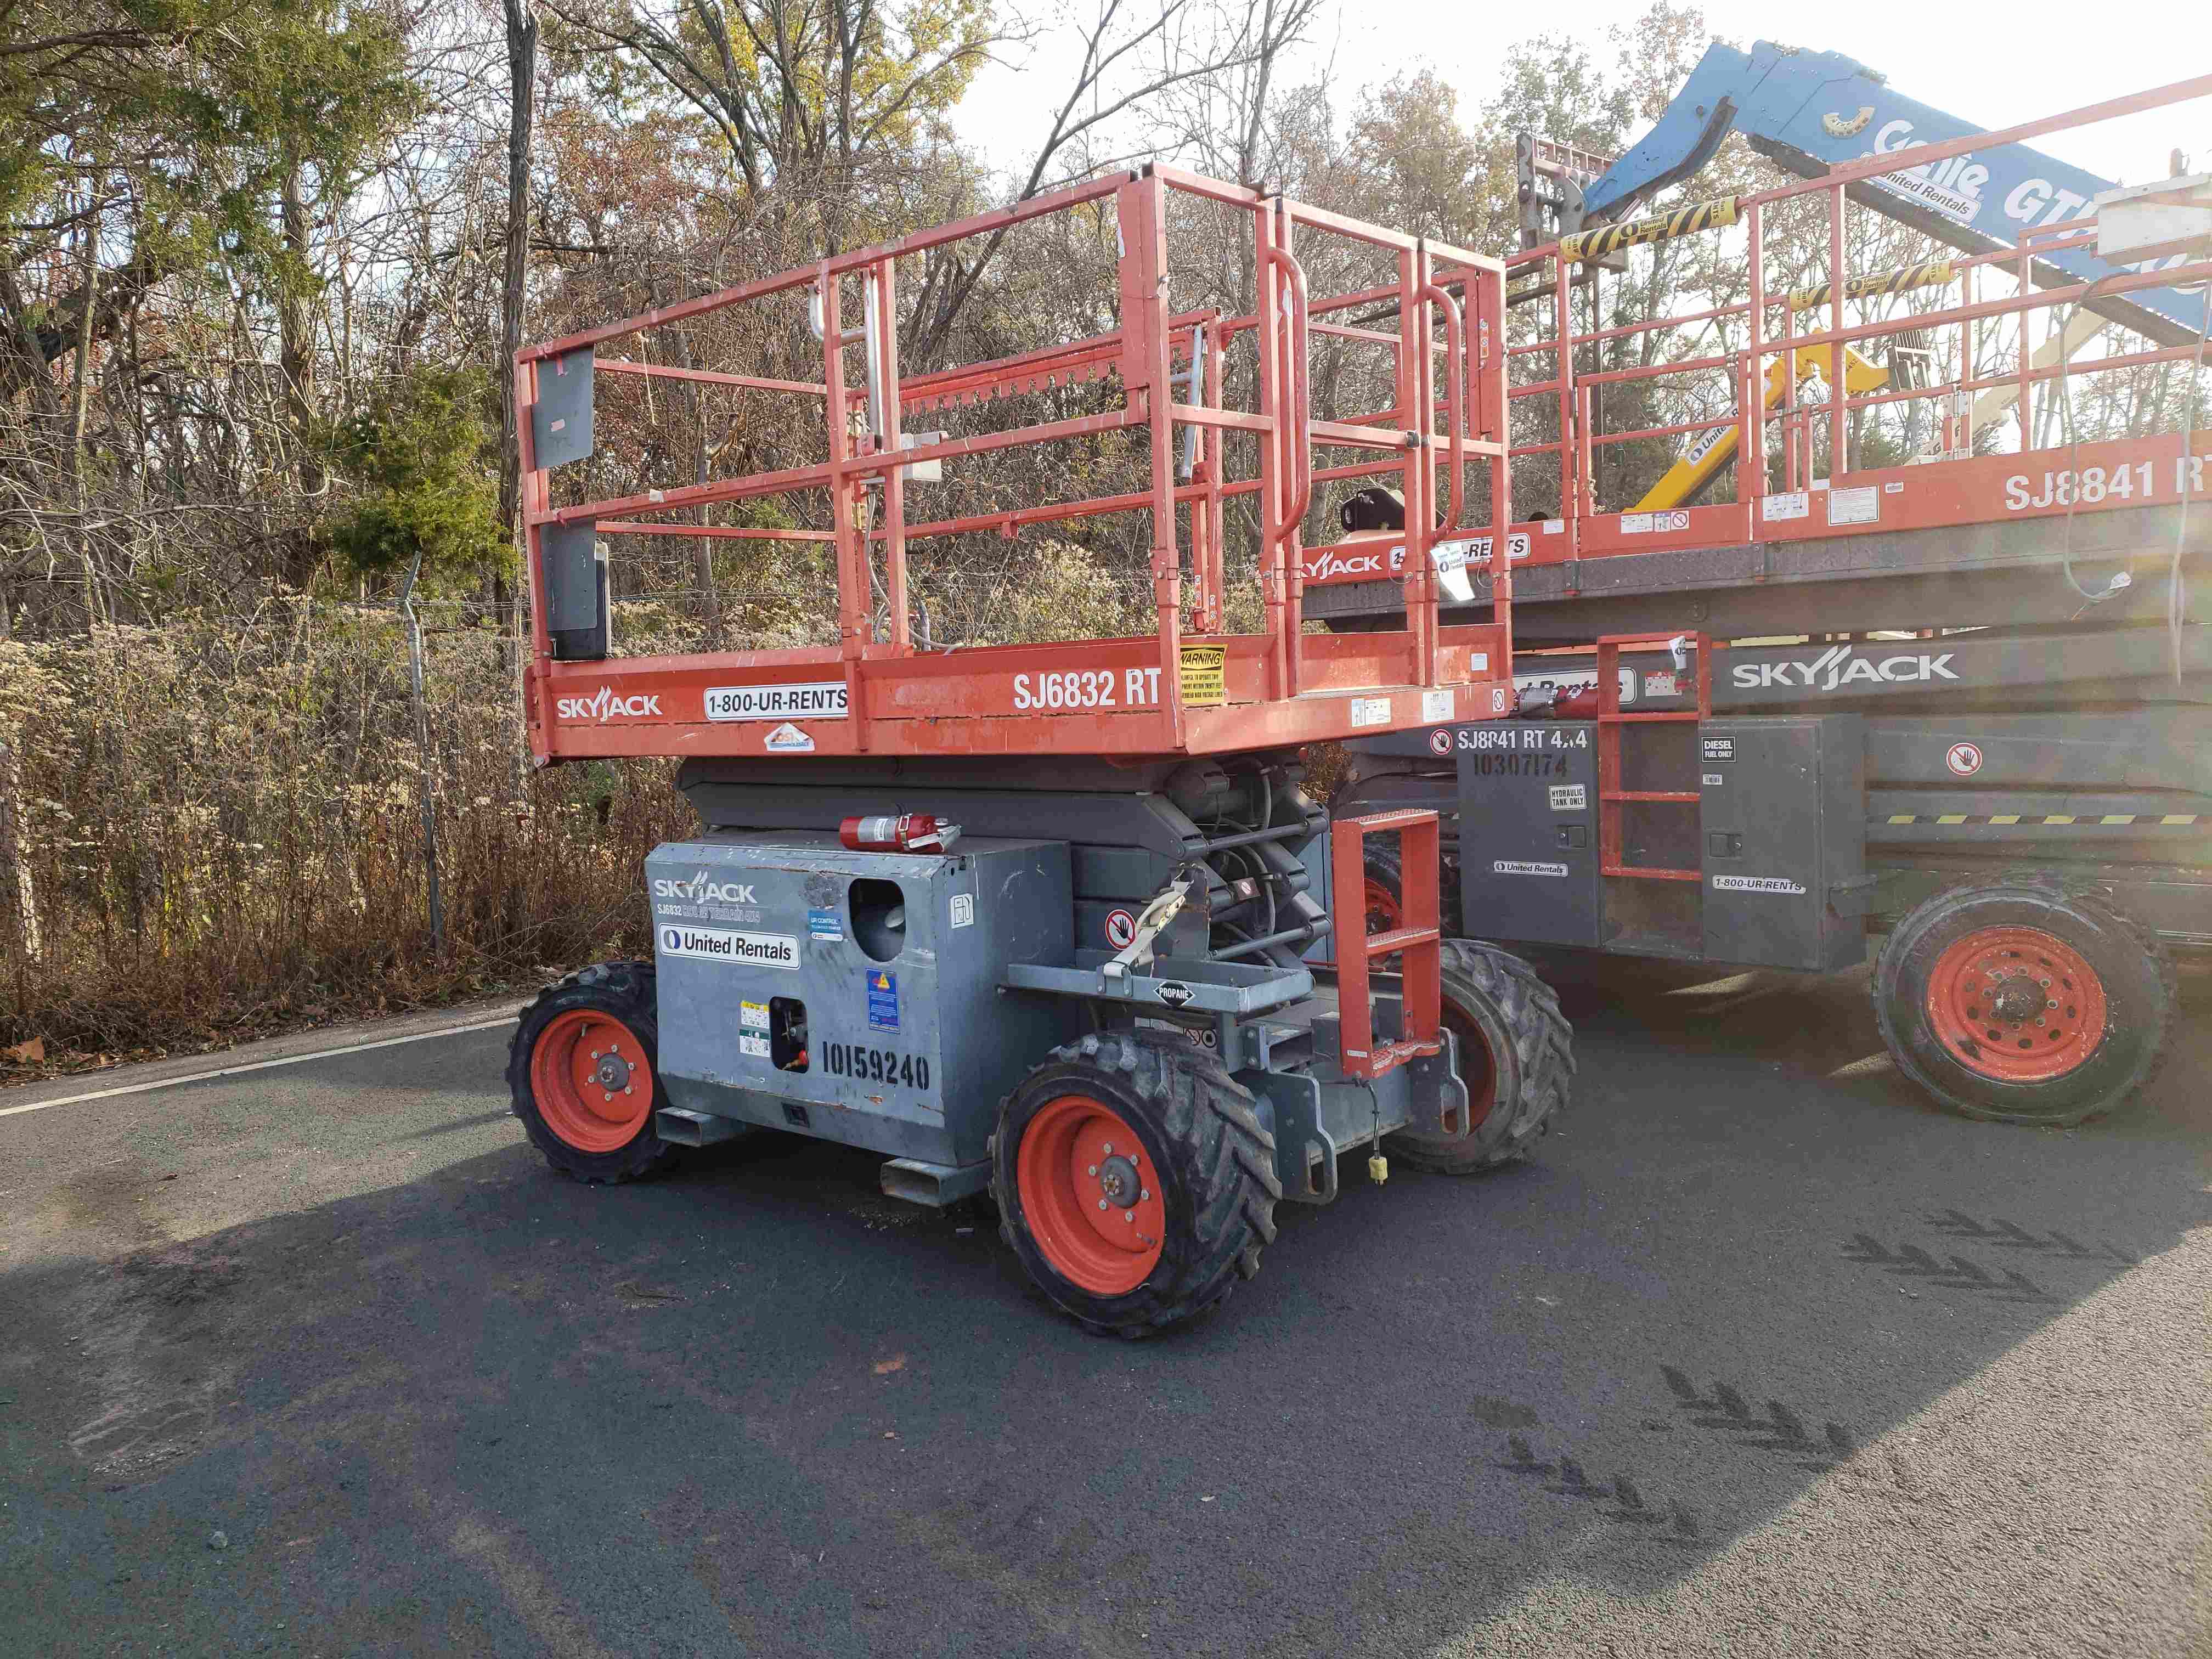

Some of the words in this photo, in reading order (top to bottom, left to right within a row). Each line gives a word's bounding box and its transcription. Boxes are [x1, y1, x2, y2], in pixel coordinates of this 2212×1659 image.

[1882, 170, 1922, 193] nited
[1921, 185, 1971, 215] Rentals
[1639, 223, 1667, 234] Rentals
[2005, 461, 2153, 510] SJ8841
[1733, 645, 1960, 691] SKYJACK
[1014, 670, 1116, 709] SJ6832
[1126, 667, 1161, 705] RT
[556, 685, 663, 722] SKYJACK
[709, 689, 847, 713] 1-800-UR-RENTS
[1523, 730, 1545, 748] RT
[1704, 740, 1733, 749] DIESEL
[1474, 753, 1569, 777] 10307174
[1551, 788, 1583, 798] HYDRAULIC
[1569, 797, 1584, 806] ONLY
[1507, 864, 1532, 872] United
[1535, 865, 1563, 873] Rentals
[654, 870, 758, 904] SKYJACK
[1716, 878, 1802, 891] 1-800-UR-RENTS
[658, 904, 682, 916] SJ6832
[685, 932, 731, 954] United
[736, 937, 792, 961] Rentals
[1159, 987, 1189, 1000] PROPANE
[822, 1041, 930, 1091] 10159240
